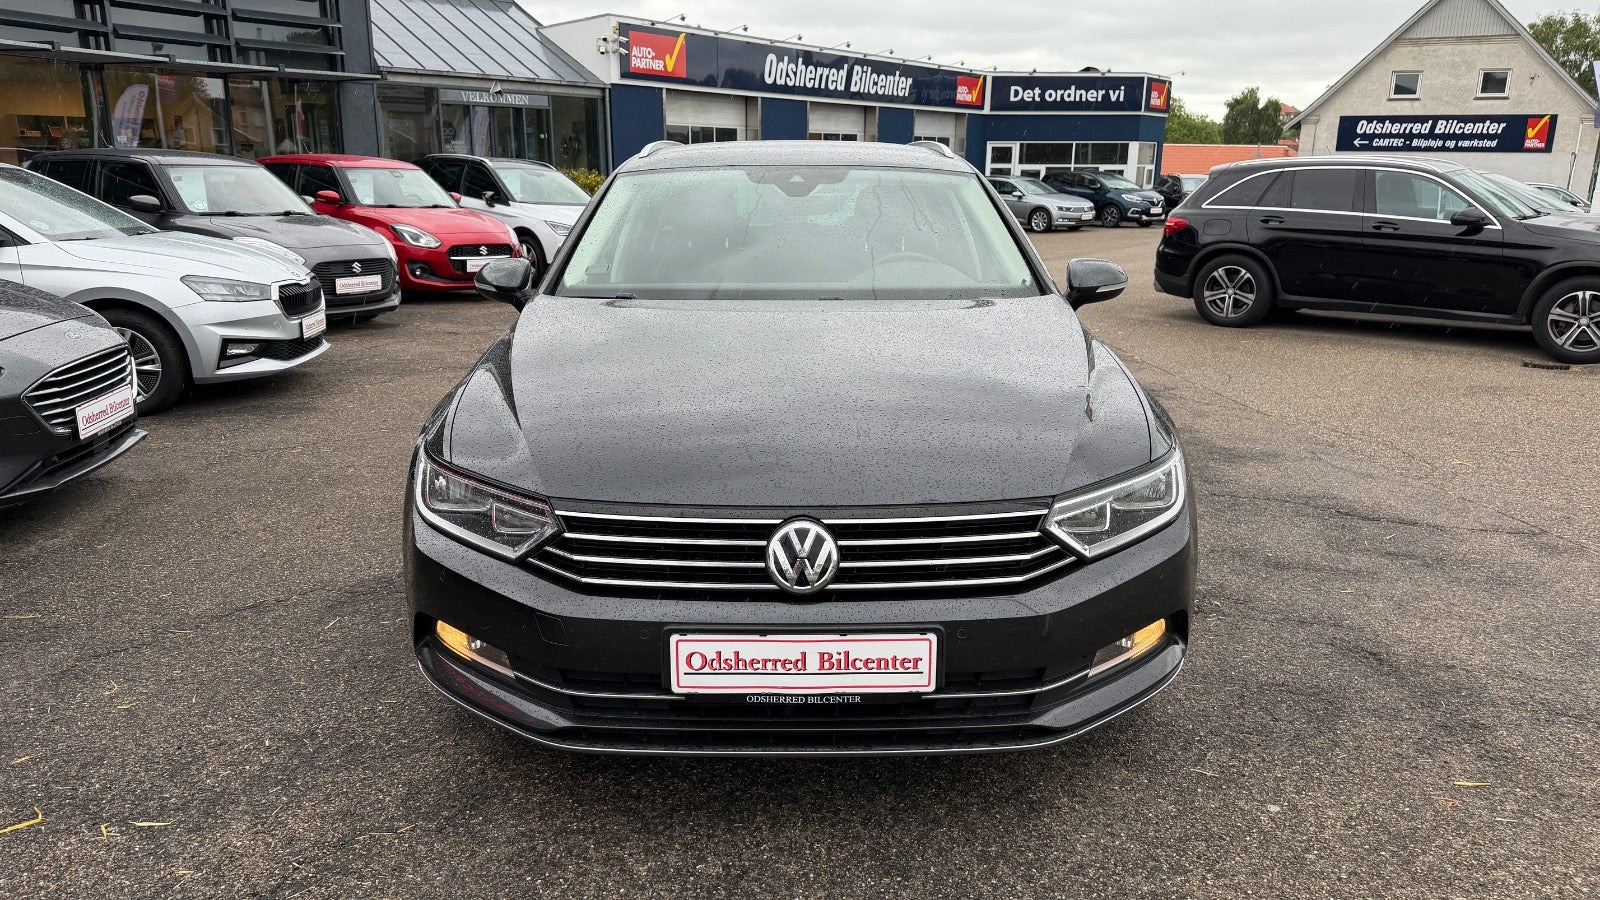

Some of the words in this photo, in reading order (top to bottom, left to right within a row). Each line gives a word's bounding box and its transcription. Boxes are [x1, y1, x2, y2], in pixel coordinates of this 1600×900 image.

[632, 46, 655, 58] AUTO-
[631, 57, 664, 71] PARTNER
[764, 53, 848, 91] Odsherred
[850, 65, 913, 97] Bilcenter
[461, 91, 529, 105] VELKOMMEN
[1010, 86, 1041, 102] Det
[1045, 86, 1105, 102] ordner
[1109, 86, 1125, 102] vi
[1356, 120, 1432, 134] Odsherred
[1434, 120, 1506, 134] Bilcenter
[1372, 138, 1404, 147] CARTEC
[1411, 138, 1443, 149] Bilpleje
[1445, 140, 1456, 148] og
[1458, 139, 1498, 148] værksted
[685, 651, 808, 671] Odsherred
[817, 650, 923, 671] Bilcenter
[746, 694, 806, 704] ODSHERRED
[807, 694, 862, 704] BILCENTER
